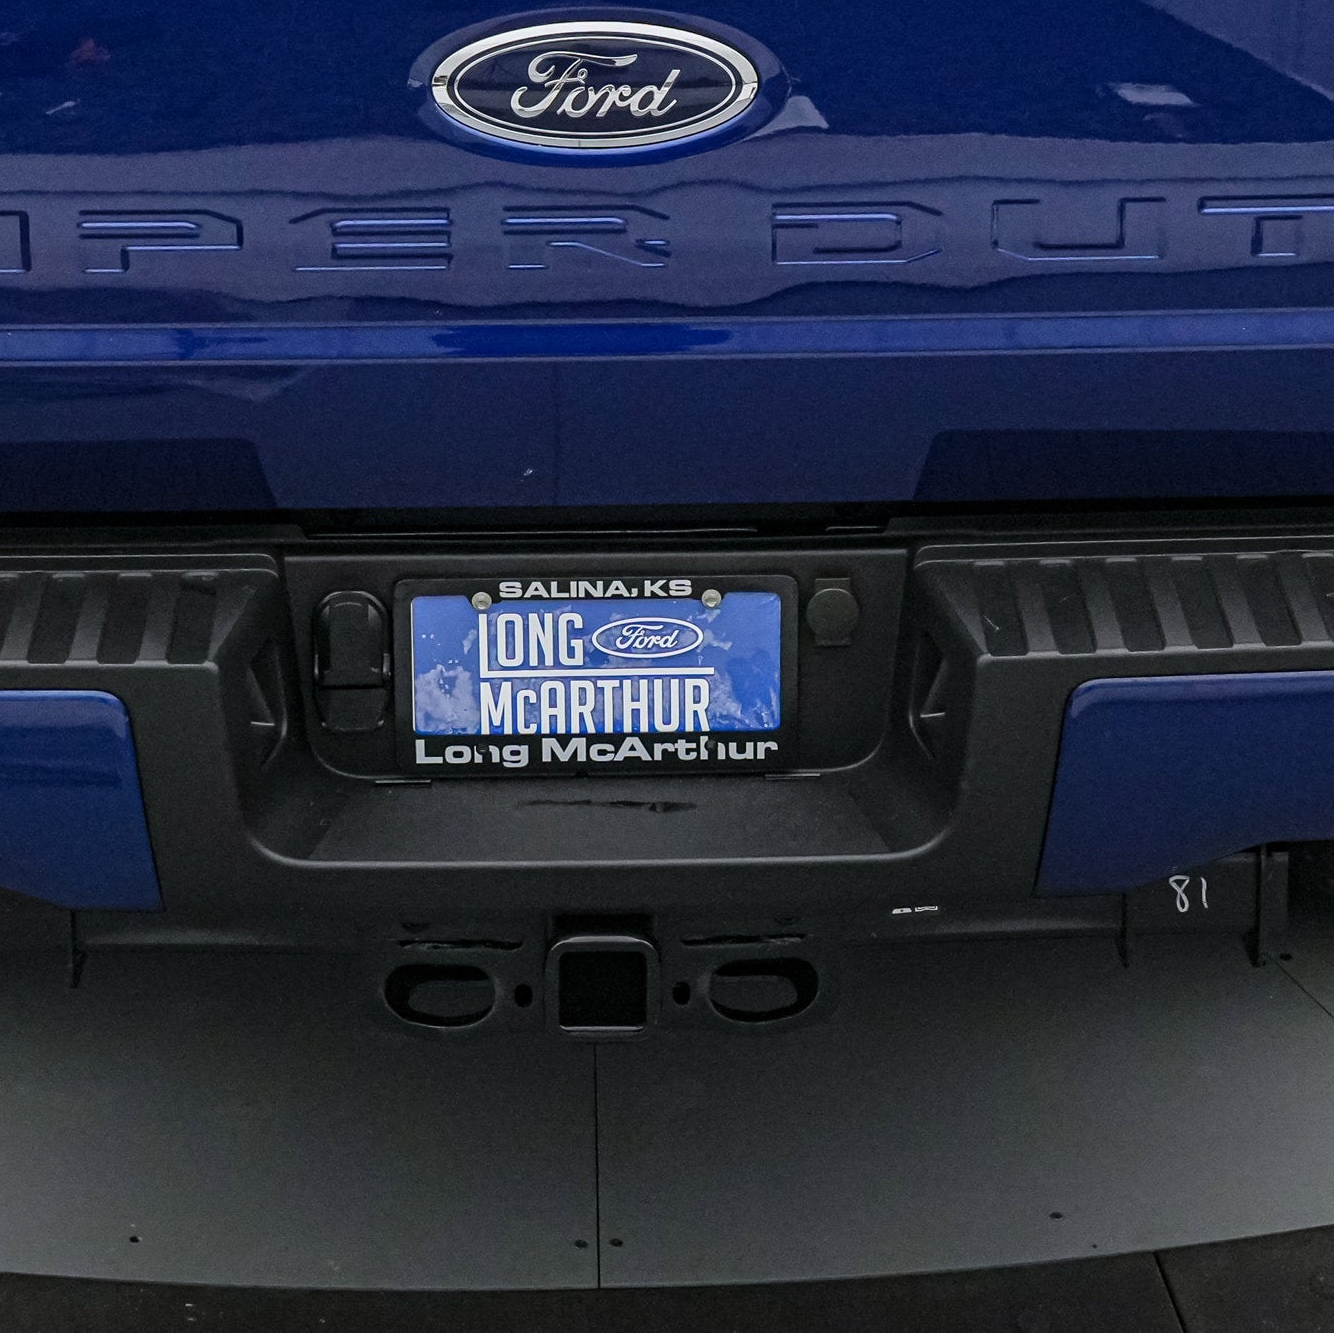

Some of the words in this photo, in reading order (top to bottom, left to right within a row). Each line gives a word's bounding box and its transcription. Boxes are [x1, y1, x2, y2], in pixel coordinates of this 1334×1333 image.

[510, 50, 681, 117] Ford
[479, 612, 584, 678] LONG
[614, 623, 680, 650] Ford
[479, 678, 711, 735] McARTHUR
[415, 738, 530, 768] Long
[541, 735, 779, 763] McArthur
[1168, 874, 1209, 913] 81
